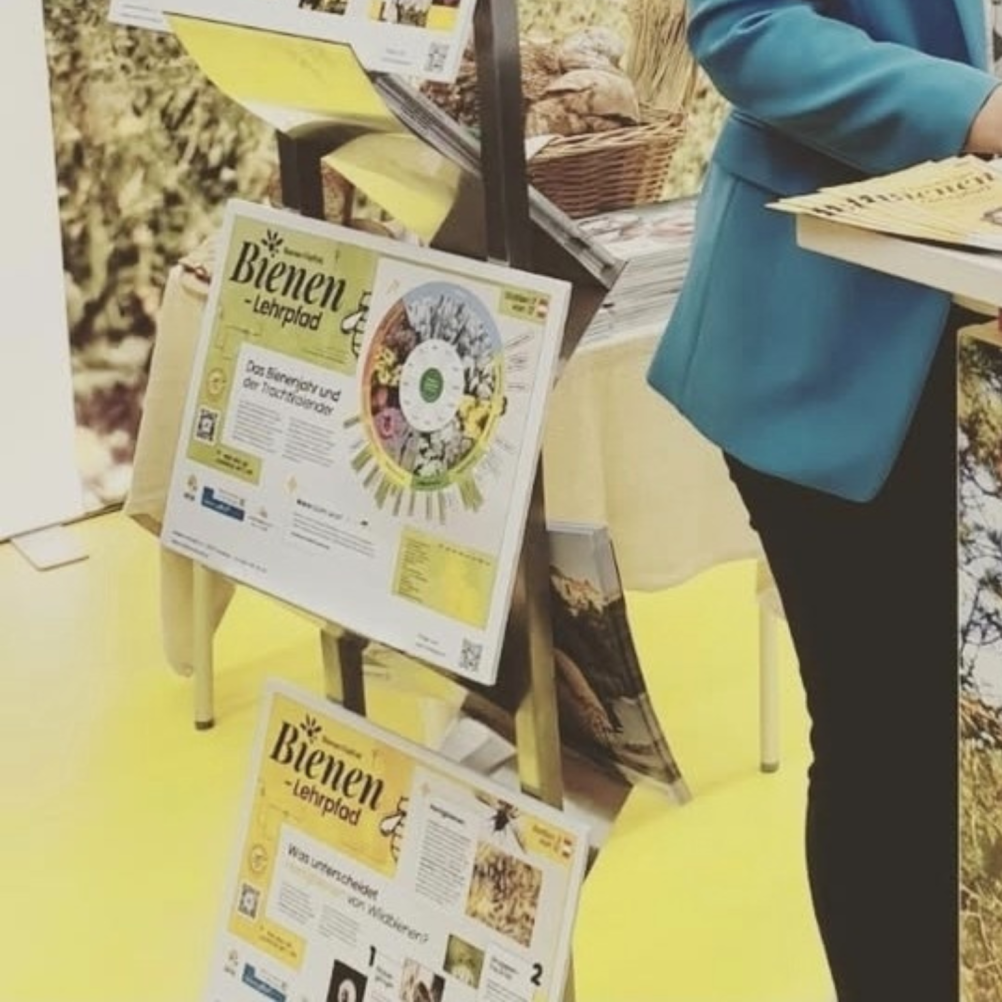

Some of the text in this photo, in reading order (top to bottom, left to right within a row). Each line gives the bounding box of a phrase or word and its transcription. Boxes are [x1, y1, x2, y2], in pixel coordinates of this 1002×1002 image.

[229, 240, 346, 313] Bienen
[270, 720, 384, 812] Bienen
[288, 844, 310, 865] Was
[368, 944, 377, 967] 1
[530, 962, 543, 987] 2
